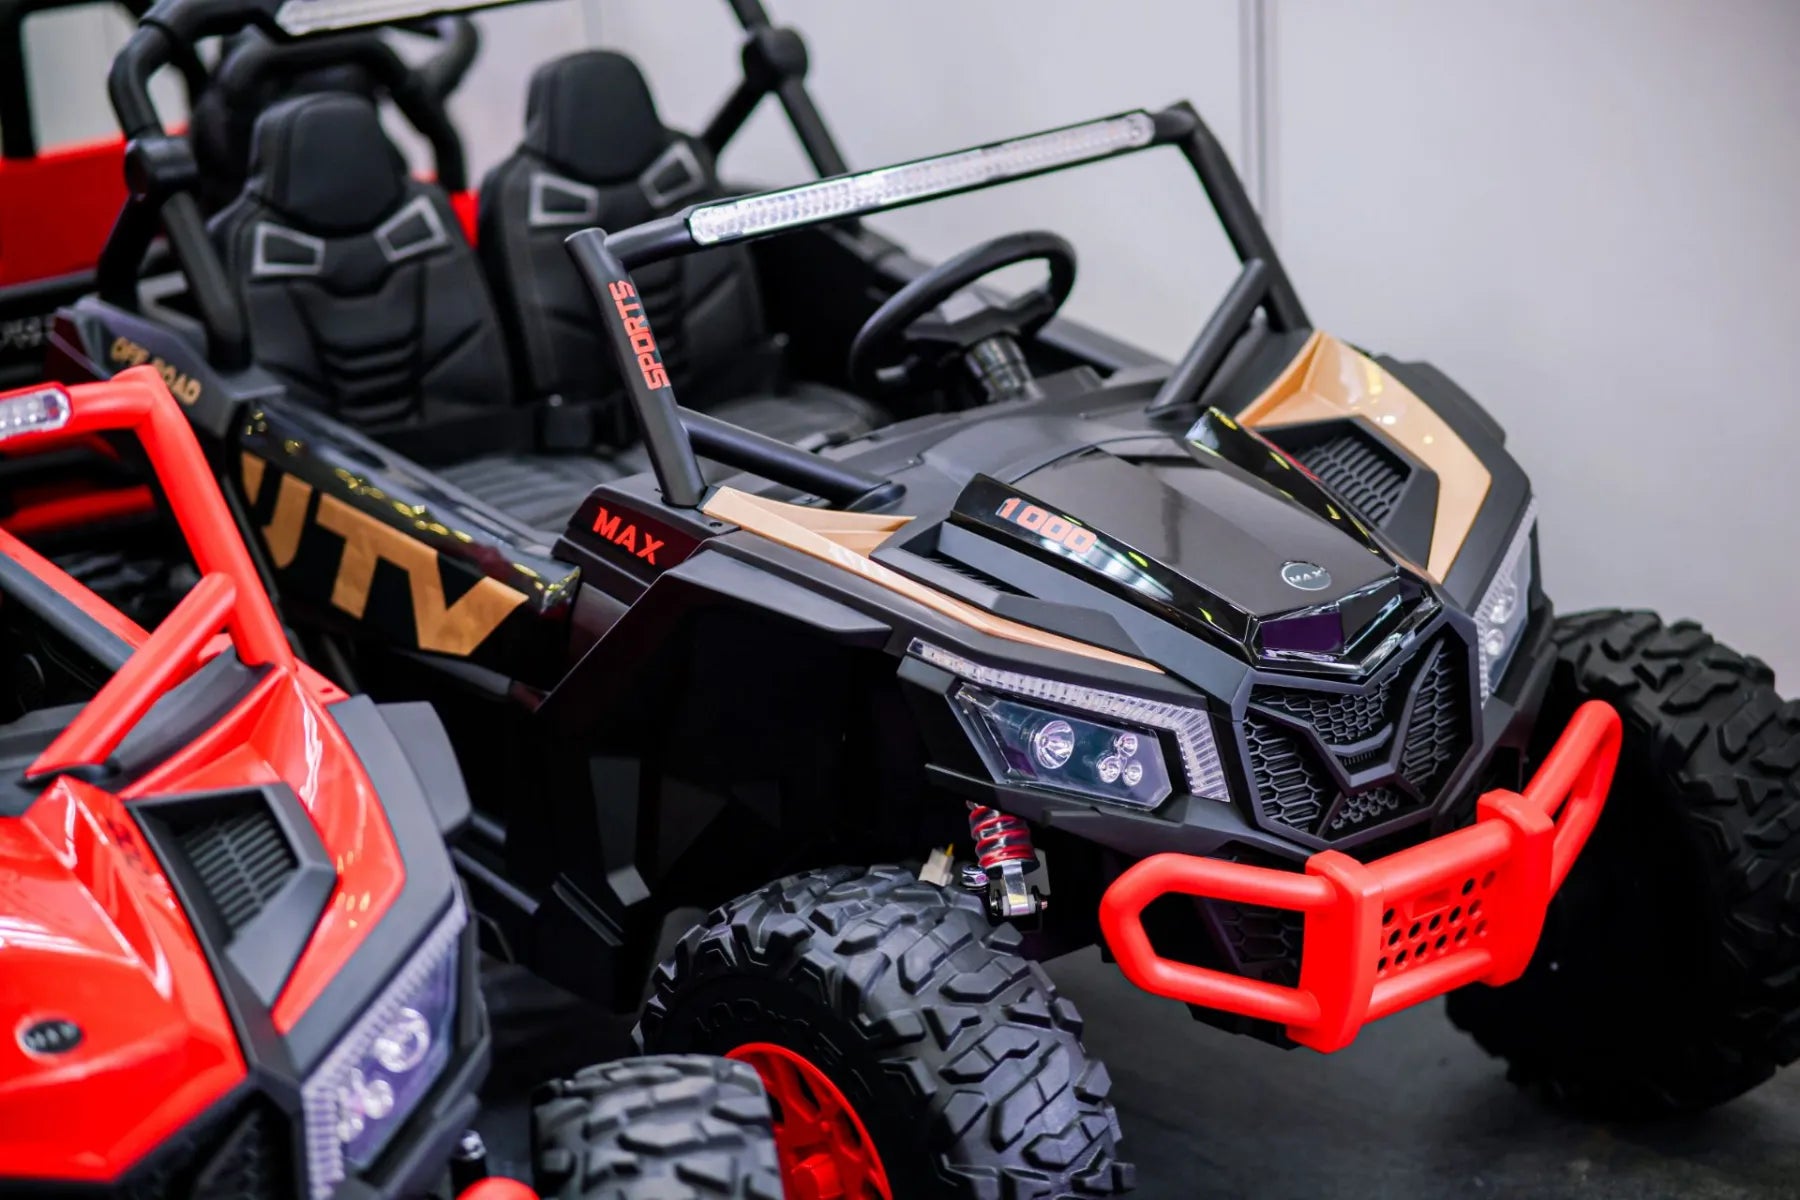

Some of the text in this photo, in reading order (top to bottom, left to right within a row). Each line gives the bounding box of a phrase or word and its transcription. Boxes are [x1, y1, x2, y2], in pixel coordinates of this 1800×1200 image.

[608, 280, 672, 390] SPORTS
[592, 505, 665, 566] MAX
[995, 497, 1098, 554] 1000
